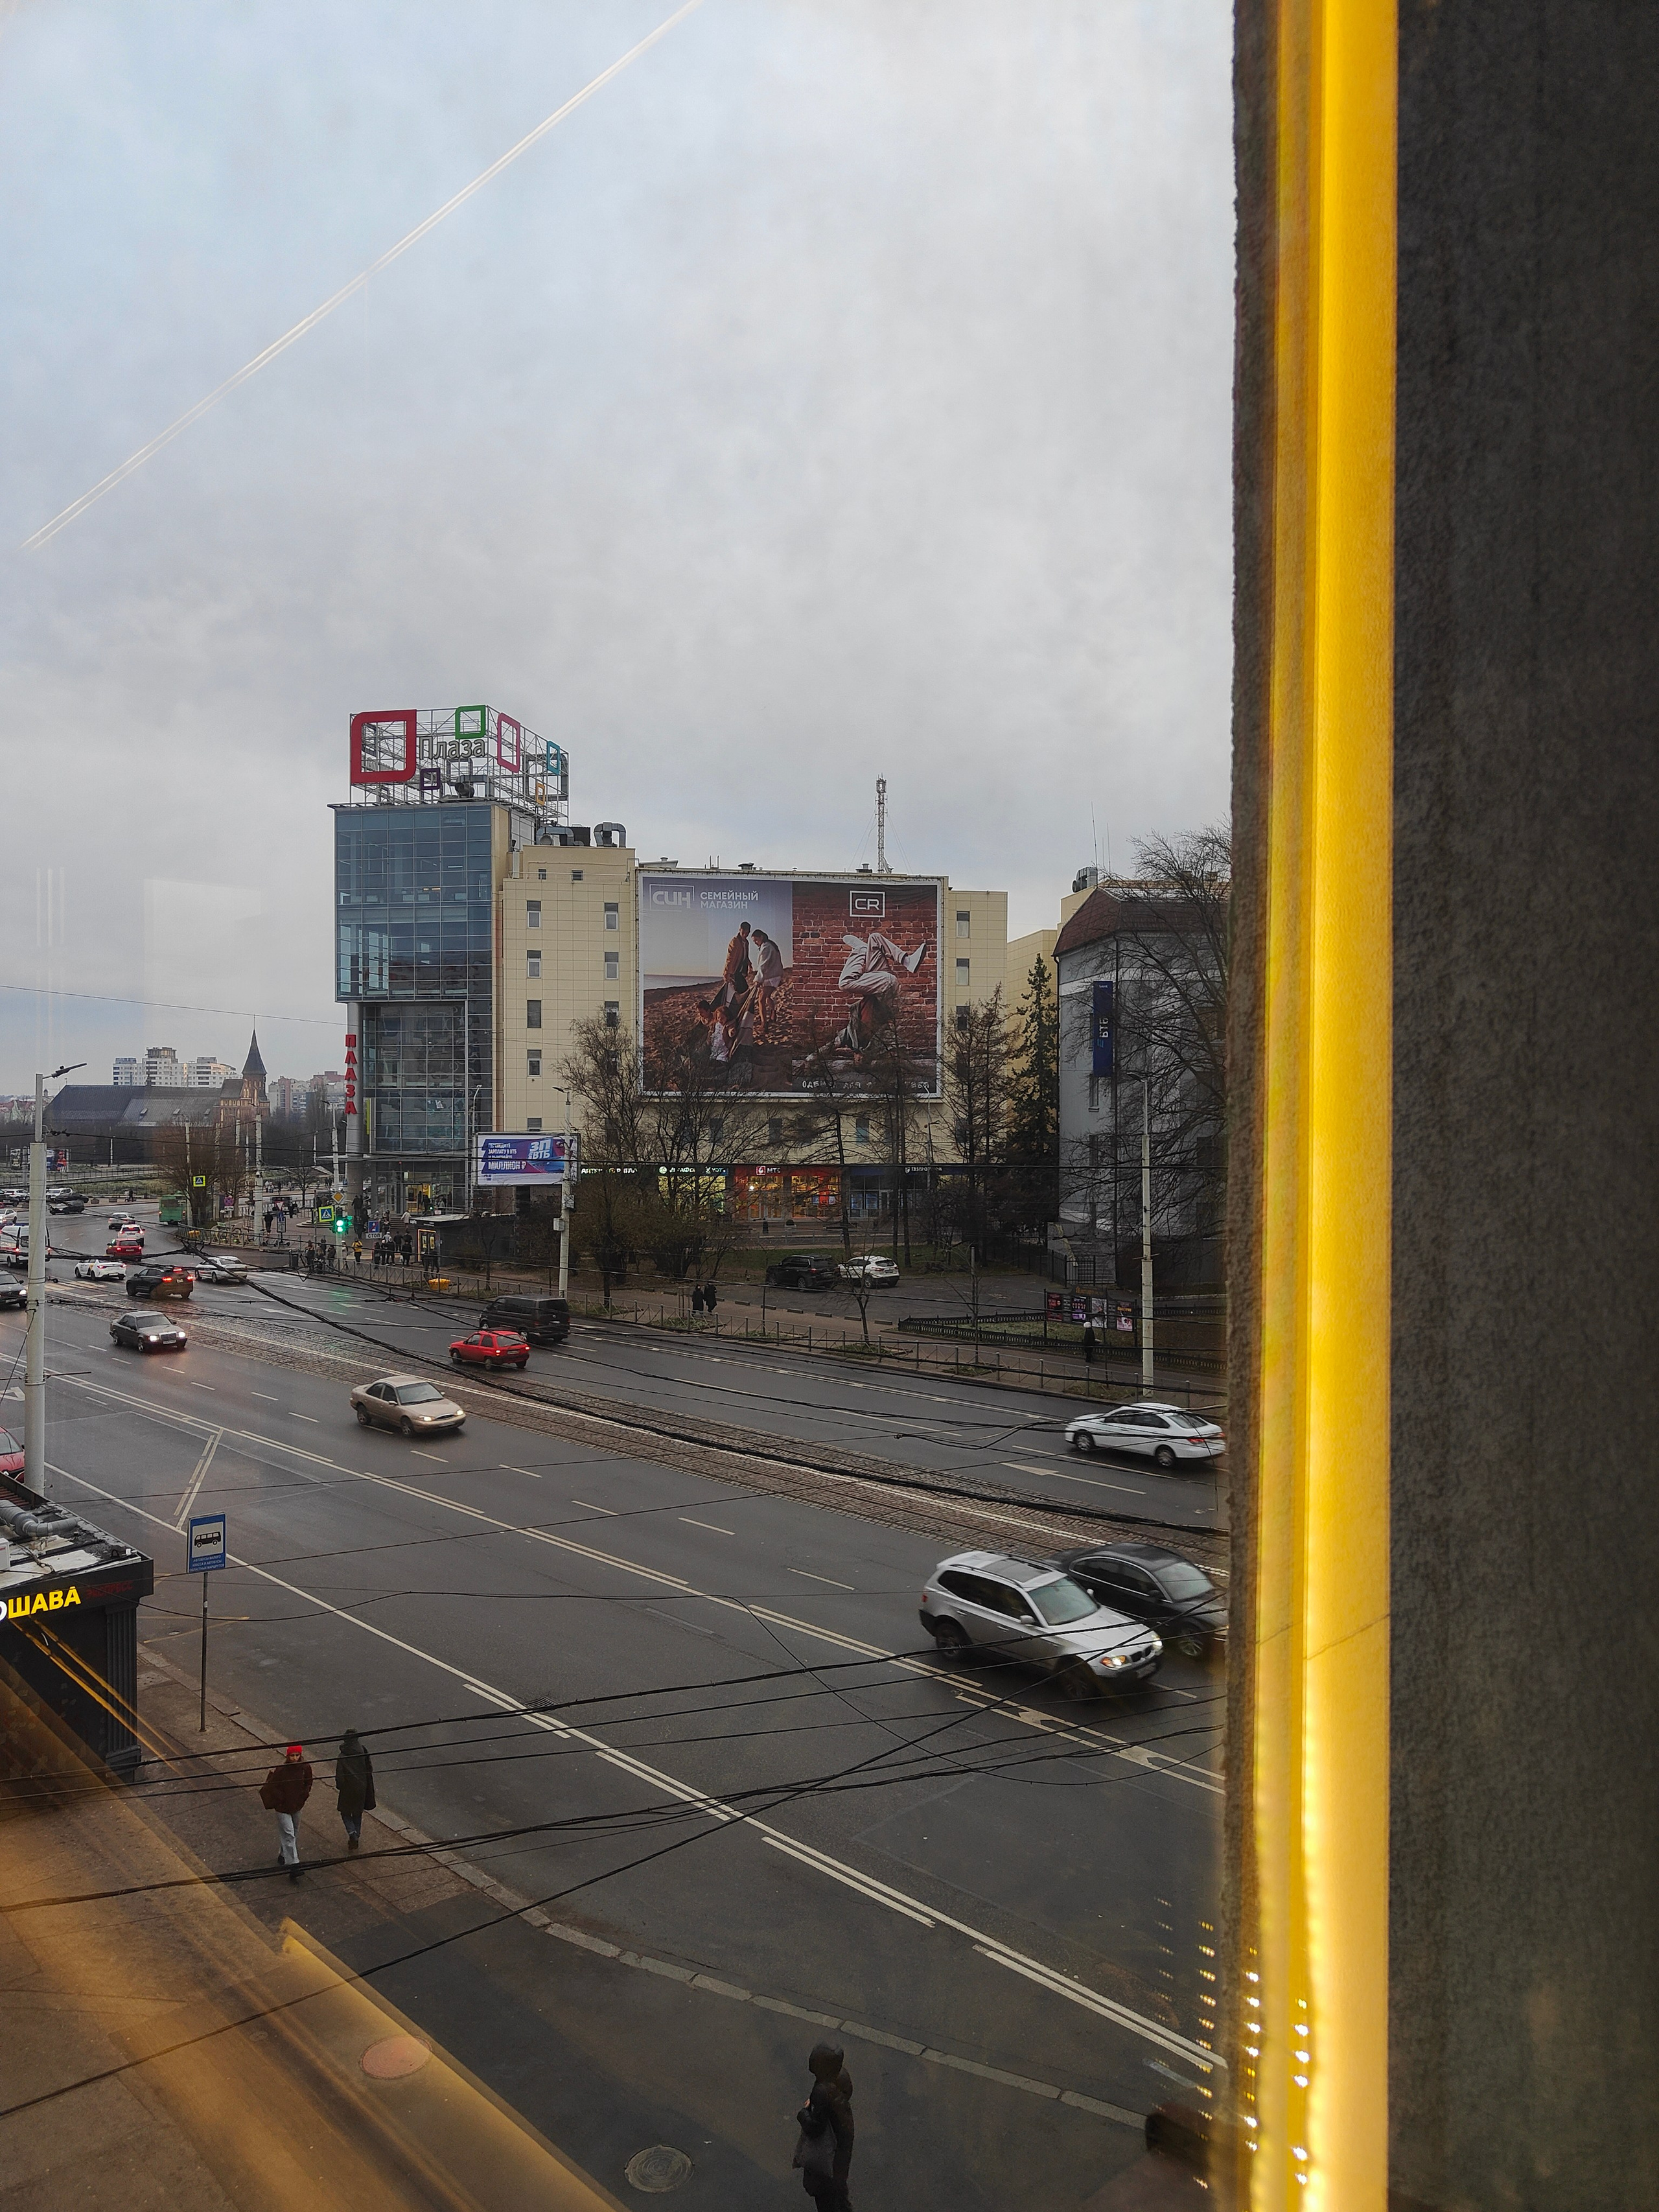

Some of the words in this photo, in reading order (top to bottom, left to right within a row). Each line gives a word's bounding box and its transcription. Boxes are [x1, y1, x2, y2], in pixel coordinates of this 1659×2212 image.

[419, 736, 486, 760] Плаза
[700, 890, 759, 901] СЕМЕЙНЫЙ
[701, 901, 748, 909] МАГАЗИН
[855, 898, 880, 911] CR
[344, 1034, 358, 1115] ПЛАЗА
[529, 1139, 551, 1152] ЗП
[532, 1150, 551, 1159] ВТБ
[488, 1161, 520, 1170] МИЛЛИОН
